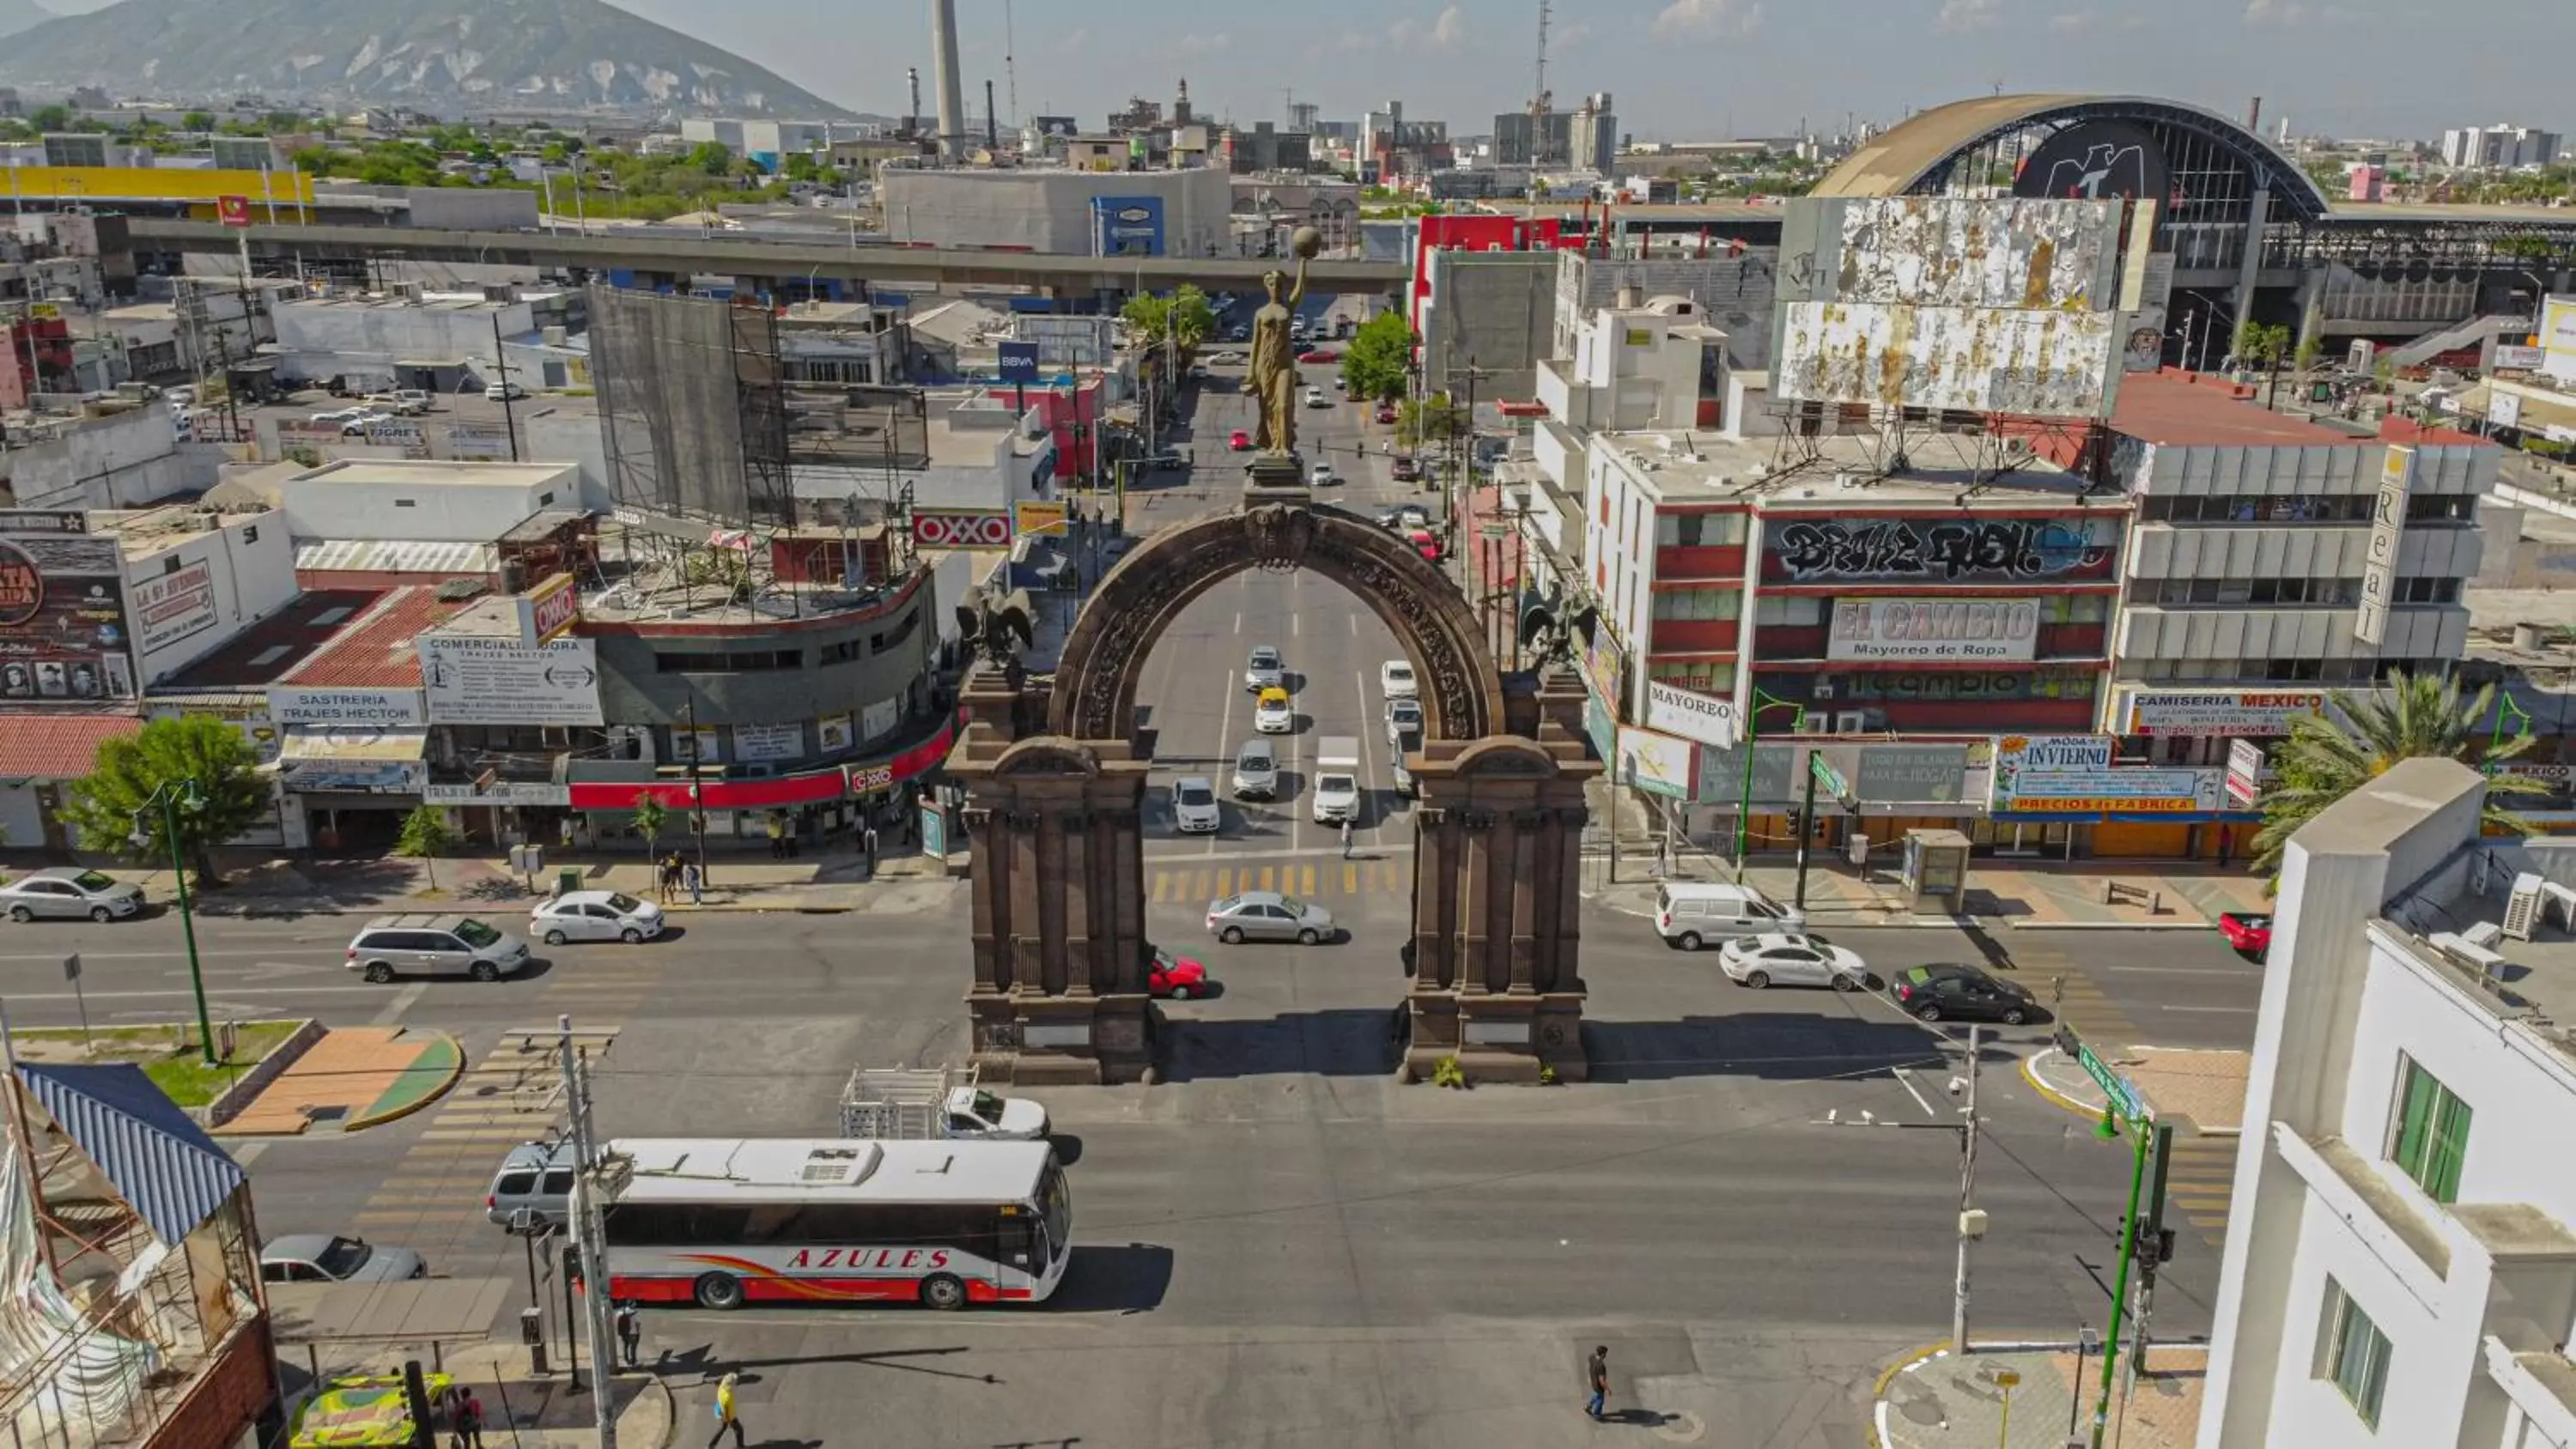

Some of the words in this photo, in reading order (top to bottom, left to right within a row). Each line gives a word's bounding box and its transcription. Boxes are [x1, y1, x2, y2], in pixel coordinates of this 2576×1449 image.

[1002, 356, 1033, 367] BBVA
[917, 516, 1008, 546] OXXO
[2354, 491, 2391, 637] Real
[538, 590, 574, 633] OXXO
[1833, 603, 1874, 641] EL
[1881, 603, 2035, 641] CAMBIO
[430, 640, 580, 651] COMERCIALIORA
[1853, 642, 1929, 657] Mayoreo
[1935, 642, 1958, 654] de
[1962, 643, 2008, 658] Ropa
[1650, 686, 1729, 718] MAYOREO
[282, 708, 342, 719] TRAJES
[346, 708, 410, 719] HECTOR
[2018, 799, 2092, 810] PRECIOS
[786, 1249, 950, 1268] AZULES
